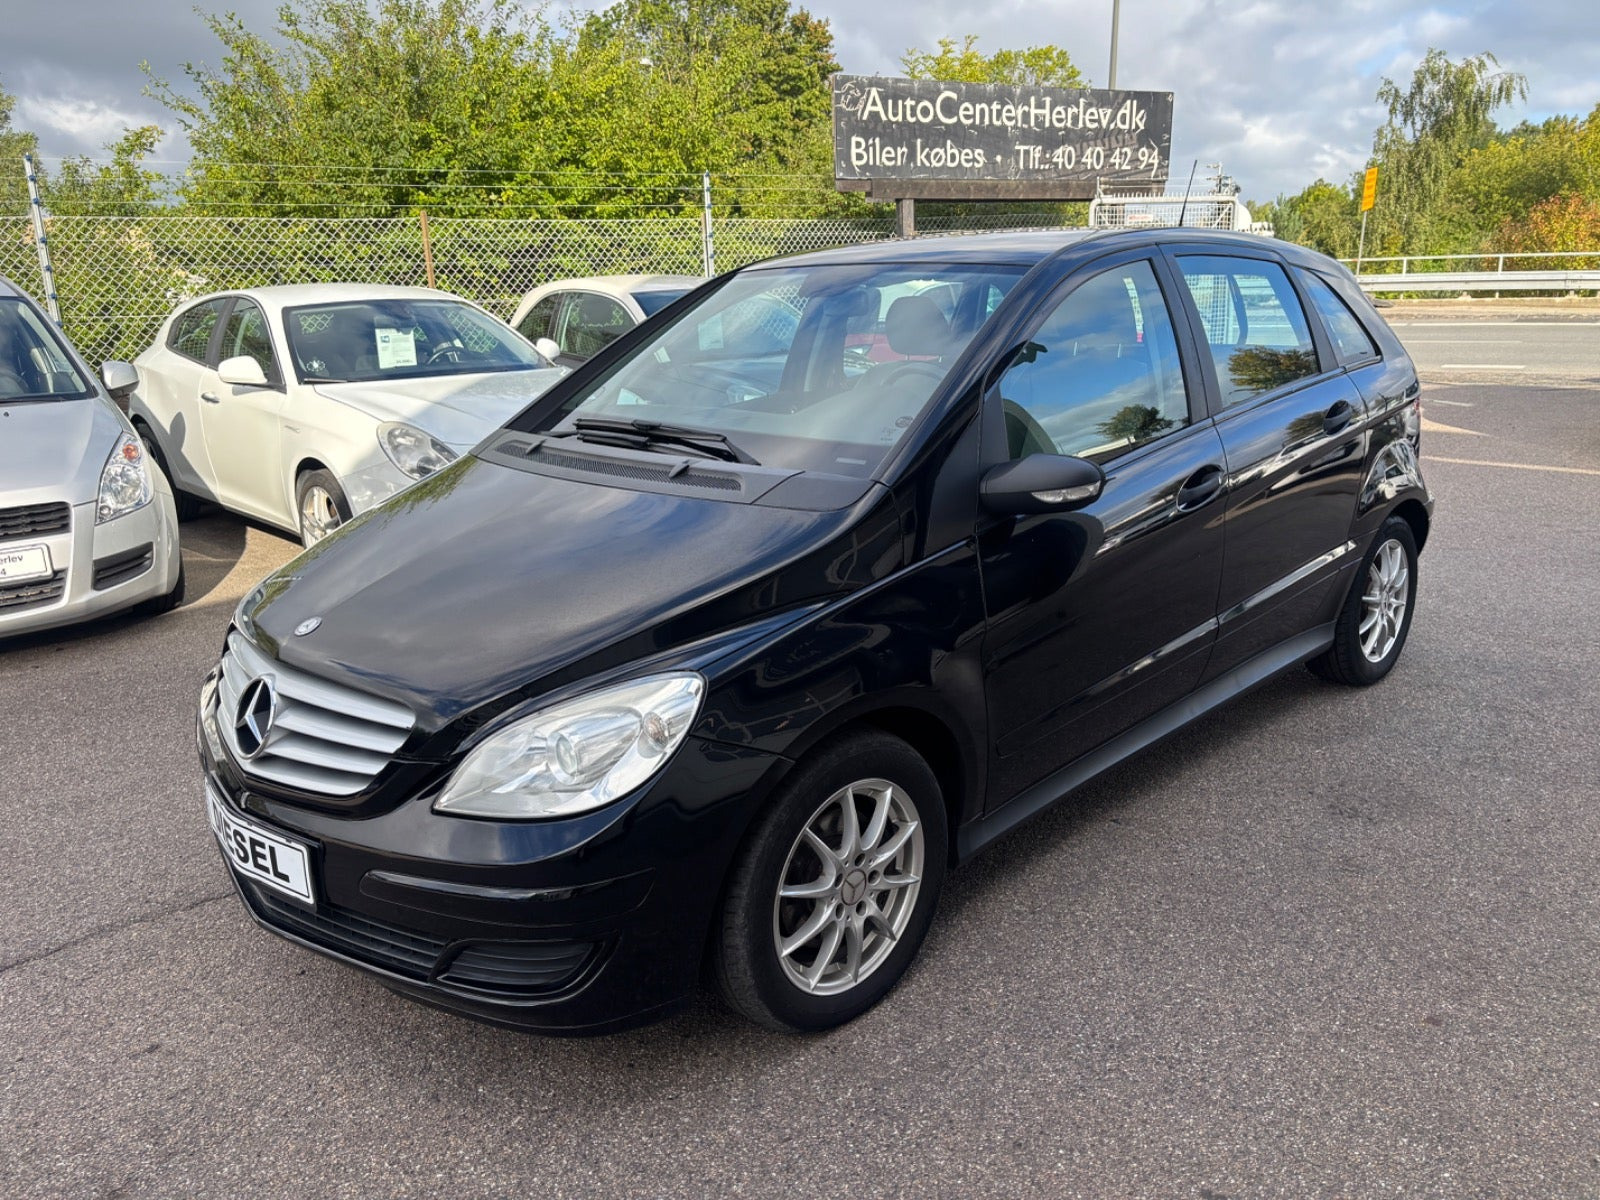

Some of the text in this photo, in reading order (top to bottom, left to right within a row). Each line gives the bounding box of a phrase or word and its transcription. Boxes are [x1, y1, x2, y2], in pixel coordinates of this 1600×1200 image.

[862, 87, 1147, 131] AutoCenterHerlev.dk
[851, 136, 908, 168] Biler
[917, 138, 986, 168] købes
[1081, 146, 1104, 170] 40
[1110, 147, 1132, 170] 42
[1138, 147, 1159, 177] 94
